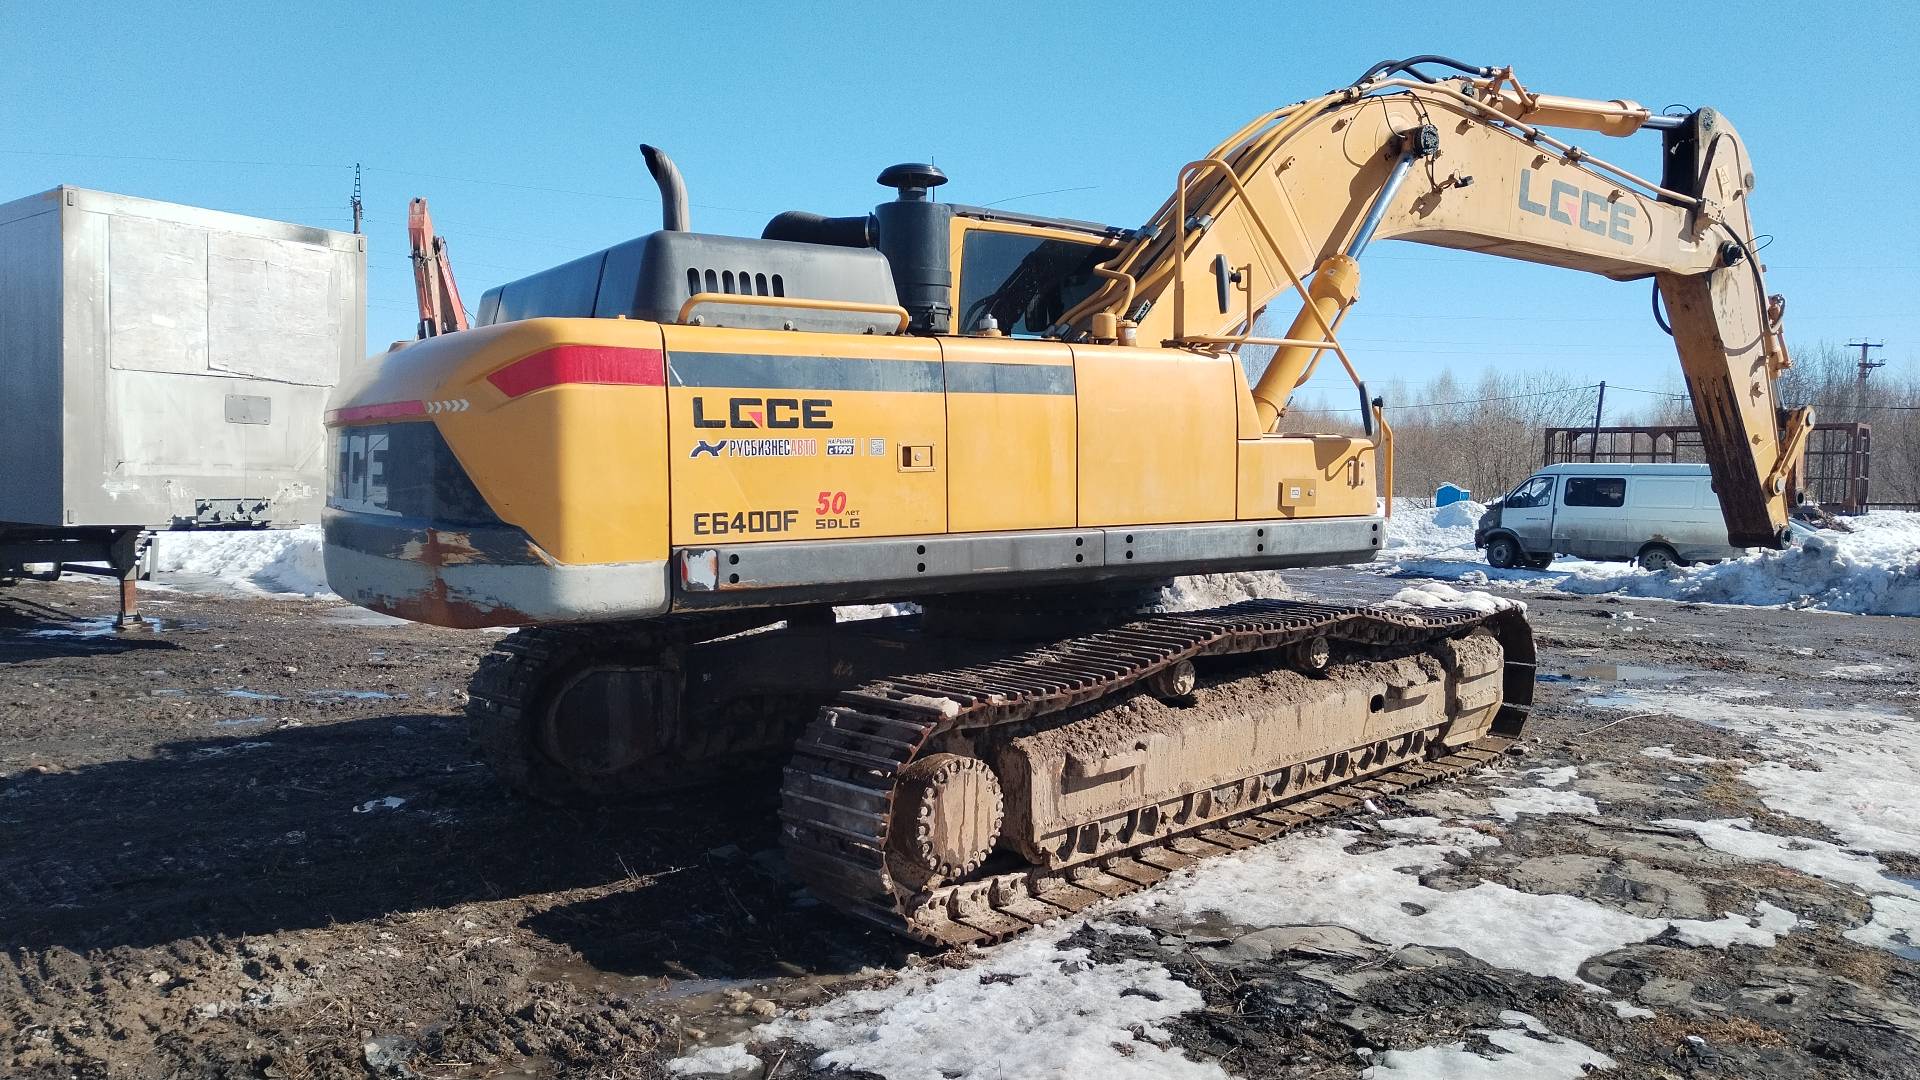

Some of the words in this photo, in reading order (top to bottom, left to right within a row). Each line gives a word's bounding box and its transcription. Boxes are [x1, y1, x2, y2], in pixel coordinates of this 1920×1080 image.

[1519, 168, 1636, 245] LGCE
[693, 397, 833, 429] LGCE
[729, 439, 816, 456] РУСБИЗНЕСАВТО
[834, 445, 852, 454] 1993
[815, 491, 847, 515] 50
[693, 510, 799, 535] E6400F
[815, 518, 860, 530] SDLG
